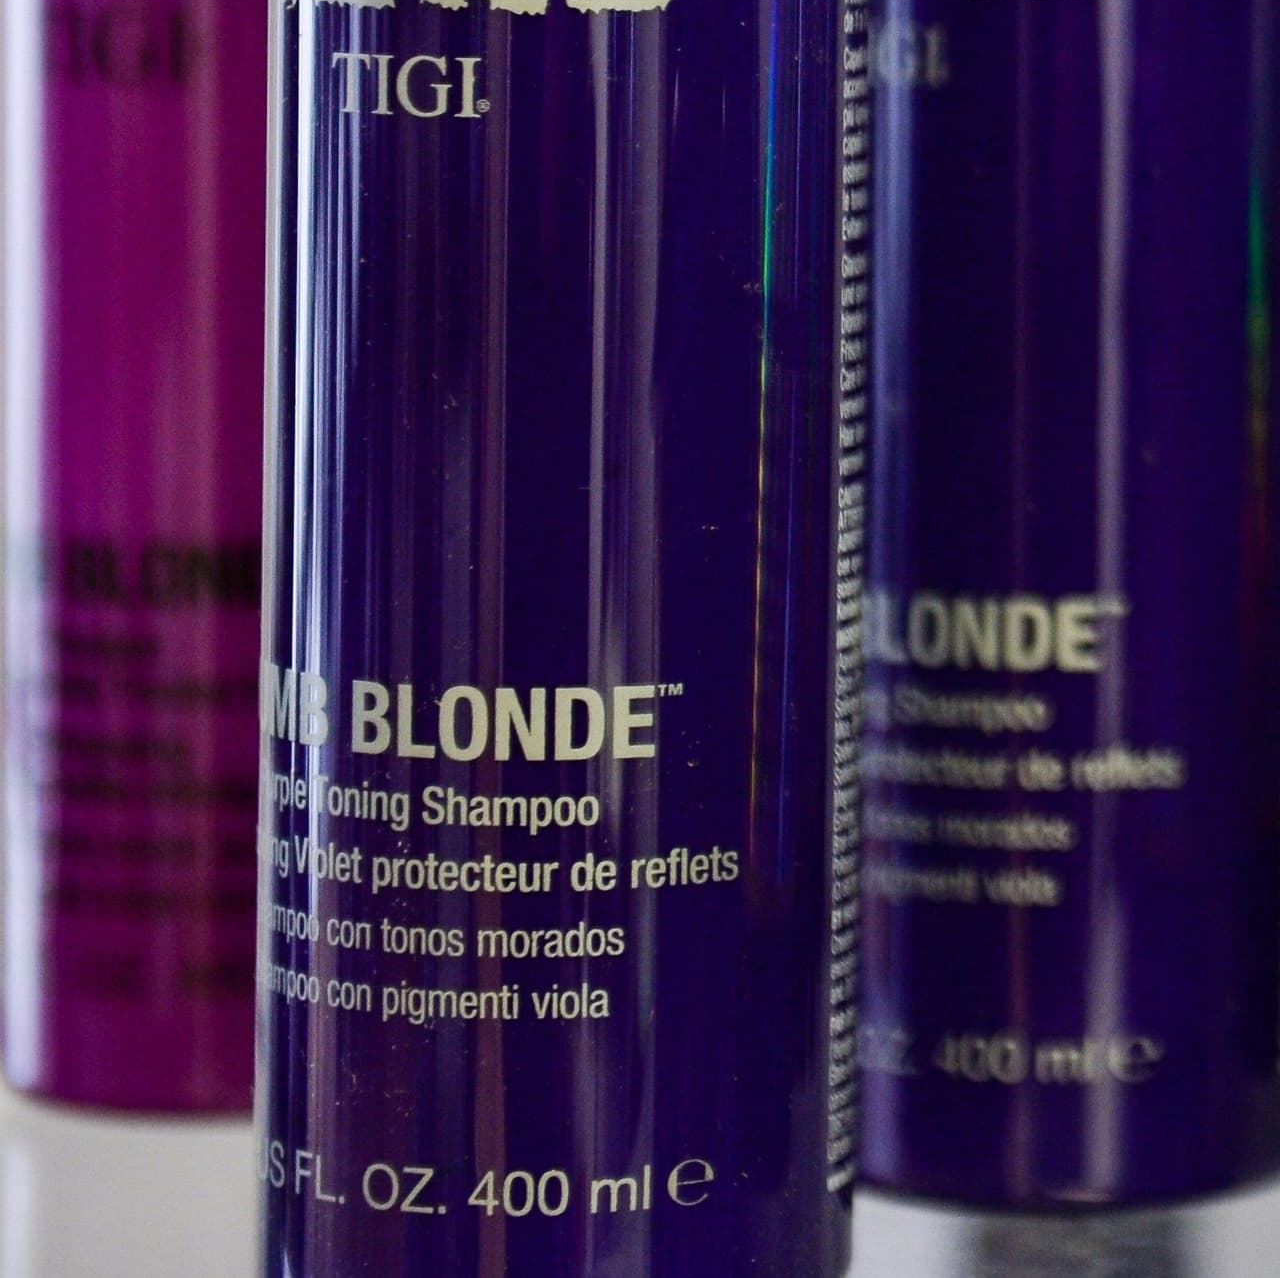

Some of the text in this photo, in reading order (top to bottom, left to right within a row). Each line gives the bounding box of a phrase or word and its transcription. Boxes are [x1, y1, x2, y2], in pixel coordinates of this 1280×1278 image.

[313, 774, 411, 832] Toning
[421, 786, 600, 835] Shampoo
[294, 834, 363, 884] Volet
[372, 852, 559, 894] protecteur
[570, 853, 616, 891] de
[630, 844, 740, 890] reflets
[327, 918, 372, 951] con
[381, 918, 465, 958] tonos
[477, 922, 625, 959] morados
[327, 979, 372, 1012] con
[382, 978, 519, 1024] pigmenti
[531, 982, 610, 1020] viola
[294, 1150, 346, 1205] FL.
[362, 1162, 446, 1215] OZ.
[467, 1169, 569, 1217] 400
[590, 1165, 652, 1215] ml
